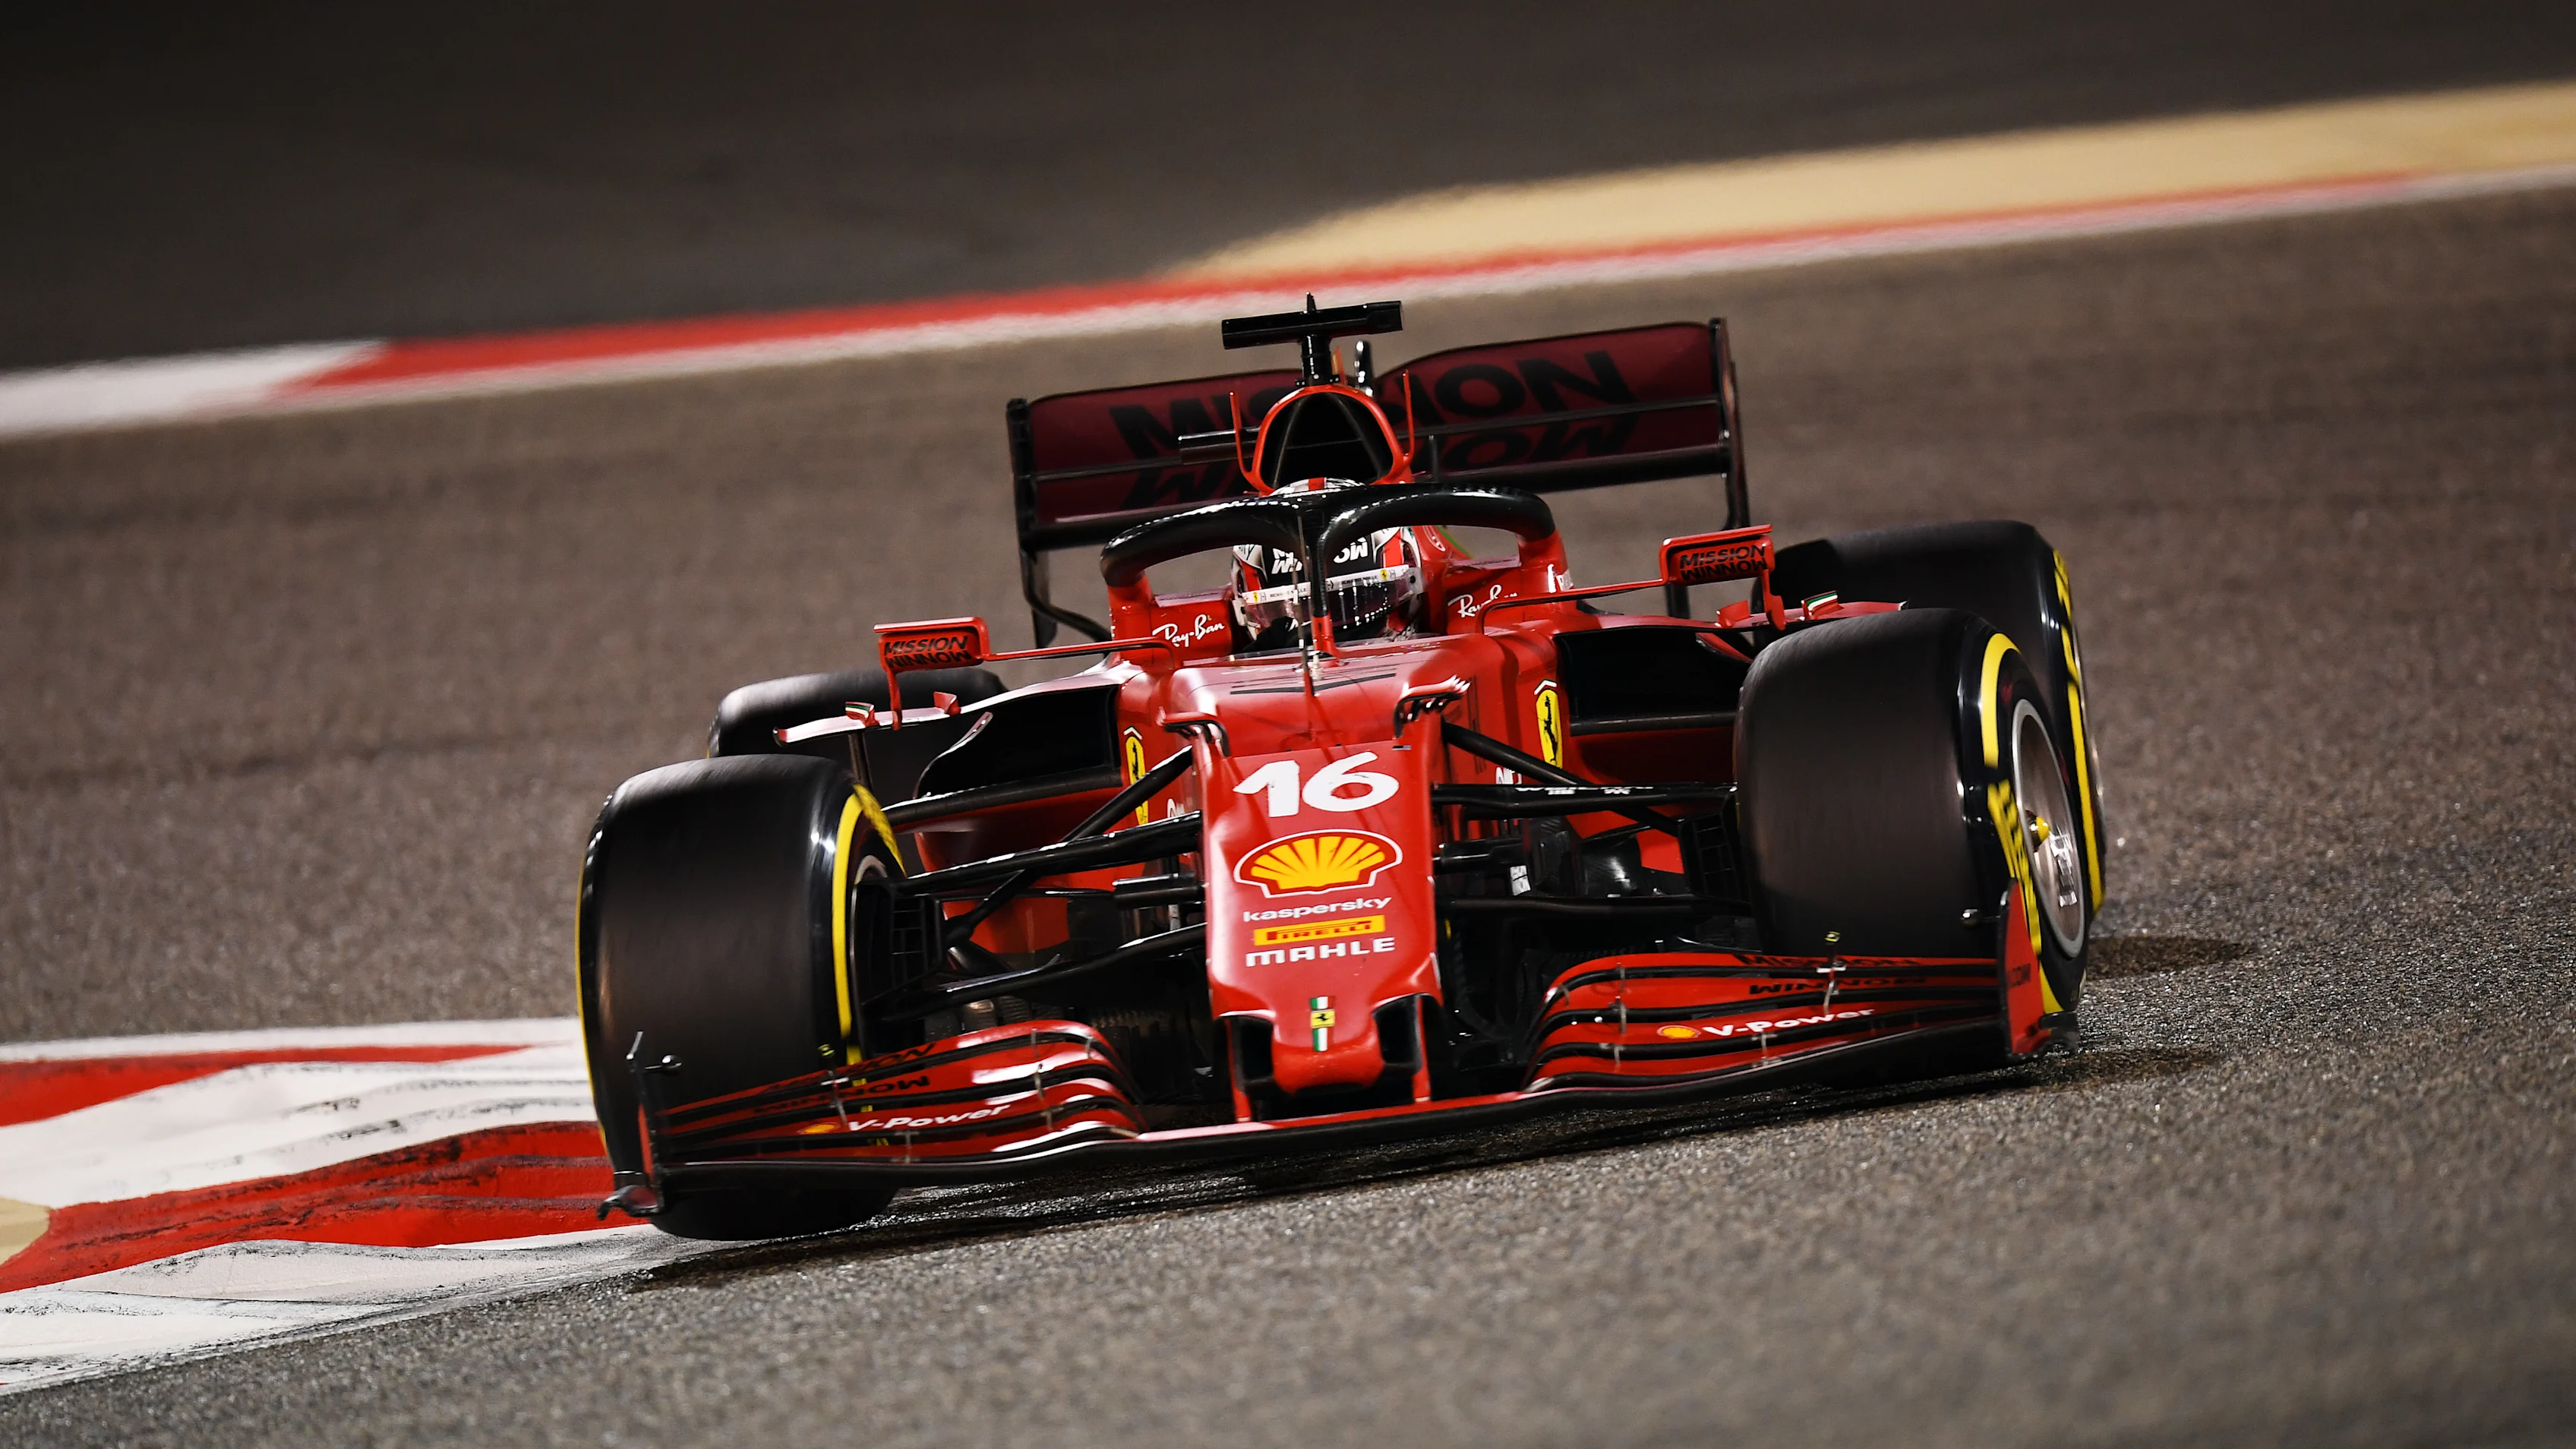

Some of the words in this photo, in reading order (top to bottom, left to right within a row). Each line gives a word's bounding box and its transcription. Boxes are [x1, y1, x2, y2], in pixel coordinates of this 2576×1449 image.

[1680, 545, 1766, 569] MISSION
[1681, 557, 1768, 581] WINNOW
[1152, 614, 1225, 647] Ray-Ban
[884, 635, 968, 655] MISSION
[885, 649, 972, 668] WINNOW
[1233, 751, 1400, 818] 16
[1242, 896, 1392, 922] kaspersky
[1266, 920, 1373, 941] PIRELLI
[1245, 937, 1396, 968] MAHLE
[1702, 1008, 1876, 1037] V-Power
[847, 1103, 1012, 1132] V-Power
